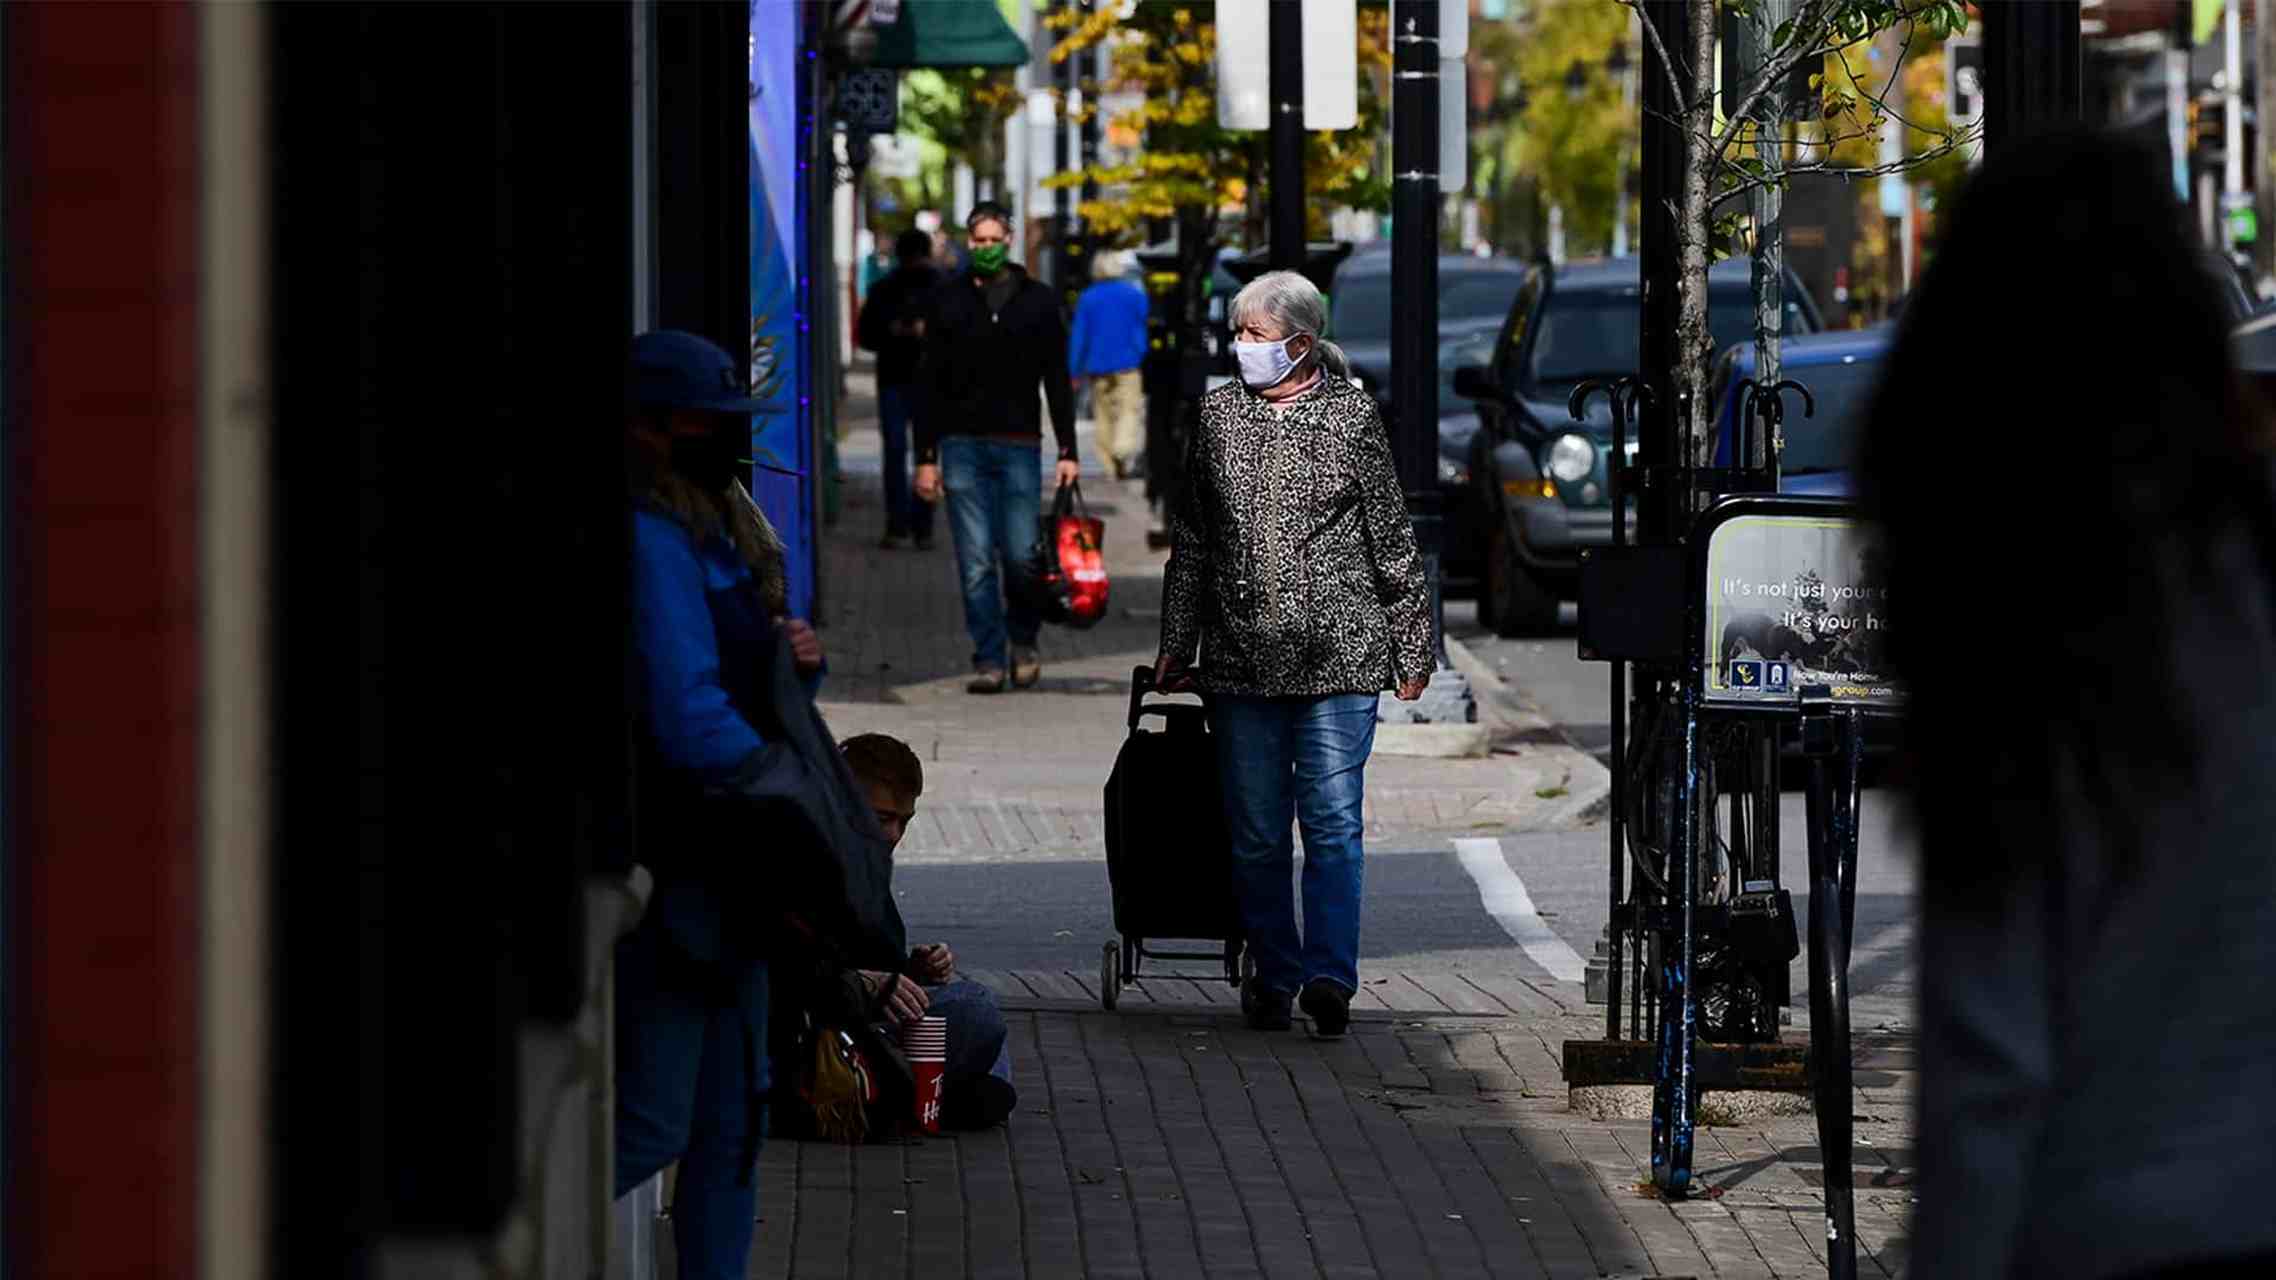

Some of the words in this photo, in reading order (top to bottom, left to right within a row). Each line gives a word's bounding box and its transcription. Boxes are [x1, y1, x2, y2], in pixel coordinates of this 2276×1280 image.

[1724, 578, 1751, 595] It's
[1758, 580, 1787, 596] not
[1793, 583, 1825, 600] just
[1832, 585, 1872, 602] your
[1784, 611, 1812, 628] It's
[1818, 614, 1859, 632] your
